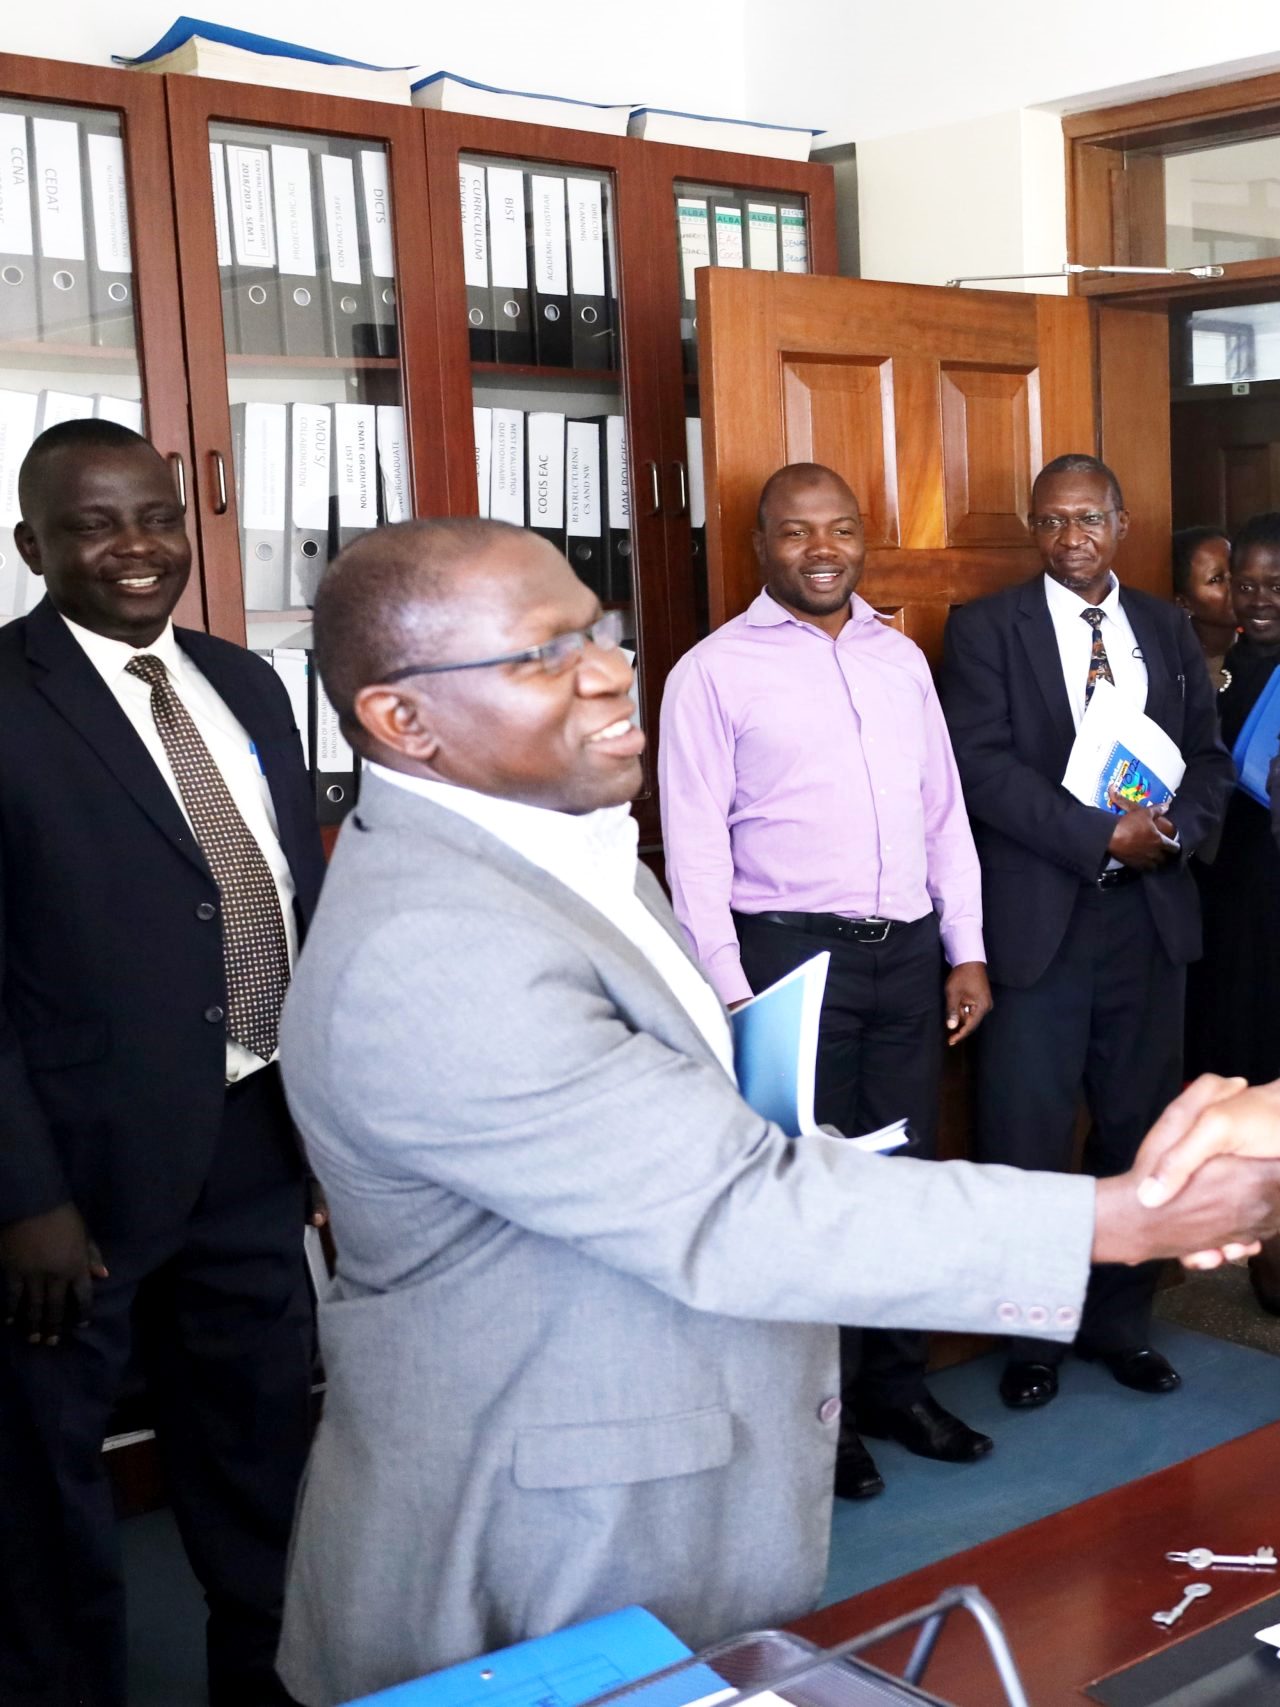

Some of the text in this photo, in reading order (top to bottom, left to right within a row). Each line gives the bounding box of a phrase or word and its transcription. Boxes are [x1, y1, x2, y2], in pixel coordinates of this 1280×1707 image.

[10, 146, 25, 186] CCNA
[44, 168, 60, 214] CEDAT
[373, 188, 386, 224] DICTS
[504, 196, 516, 224] BIST
[681, 209, 704, 217] ALBA
[245, 216, 254, 236] SEM
[333, 195, 345, 268] CONTRACT STAFF
[472, 179, 483, 260] CURRICULUM
[543, 194, 554, 281] ACADEMIC REGISTRAR
[578, 202, 586, 242] PLANNING
[591, 203, 599, 241] DIRECTOR
[717, 215, 740, 224] ALBA
[751, 214, 775, 222] ALBA
[297, 416, 308, 488] COLLABORATION
[313, 419, 327, 470] MOU'S/
[344, 445, 354, 484] LIST 2018
[356, 420, 367, 510] SENATE GRADUATION
[497, 422, 506, 490] QUESTIONNAIRES
[509, 445, 517, 497] EVALUATION
[537, 454, 549, 515] COCIS EAC
[571, 447, 579, 523] RESTRUCTURING
[583, 464, 591, 515] CS AND NW
[621, 489, 630, 516] MAK
